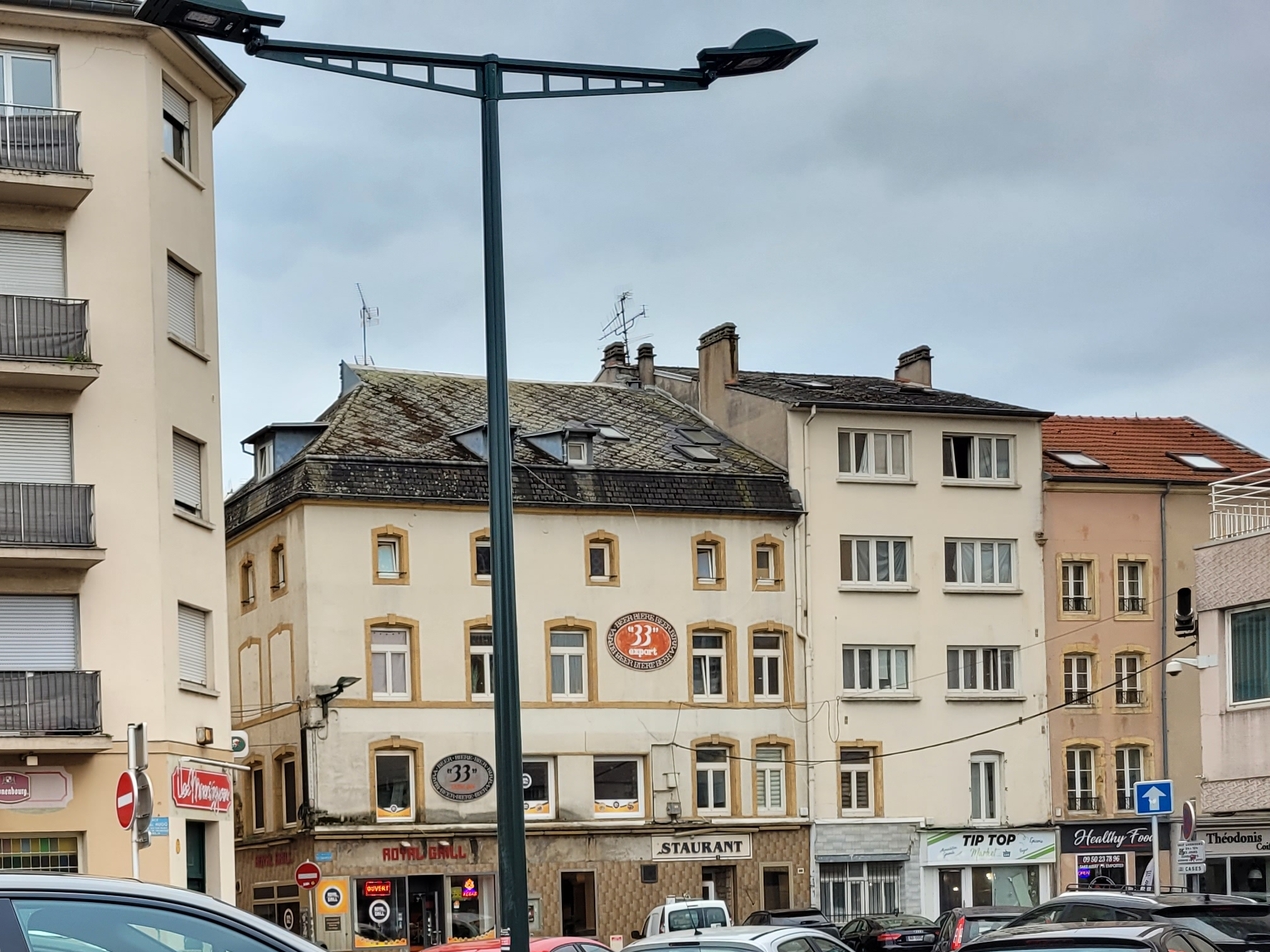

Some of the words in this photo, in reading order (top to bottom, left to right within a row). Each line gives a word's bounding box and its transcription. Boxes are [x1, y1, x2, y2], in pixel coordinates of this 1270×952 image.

[963, 834, 985, 846] TIP
[988, 833, 1016, 846] TOP
[1074, 829, 1127, 848] Healthy
[1206, 831, 1263, 844] Théodonis
